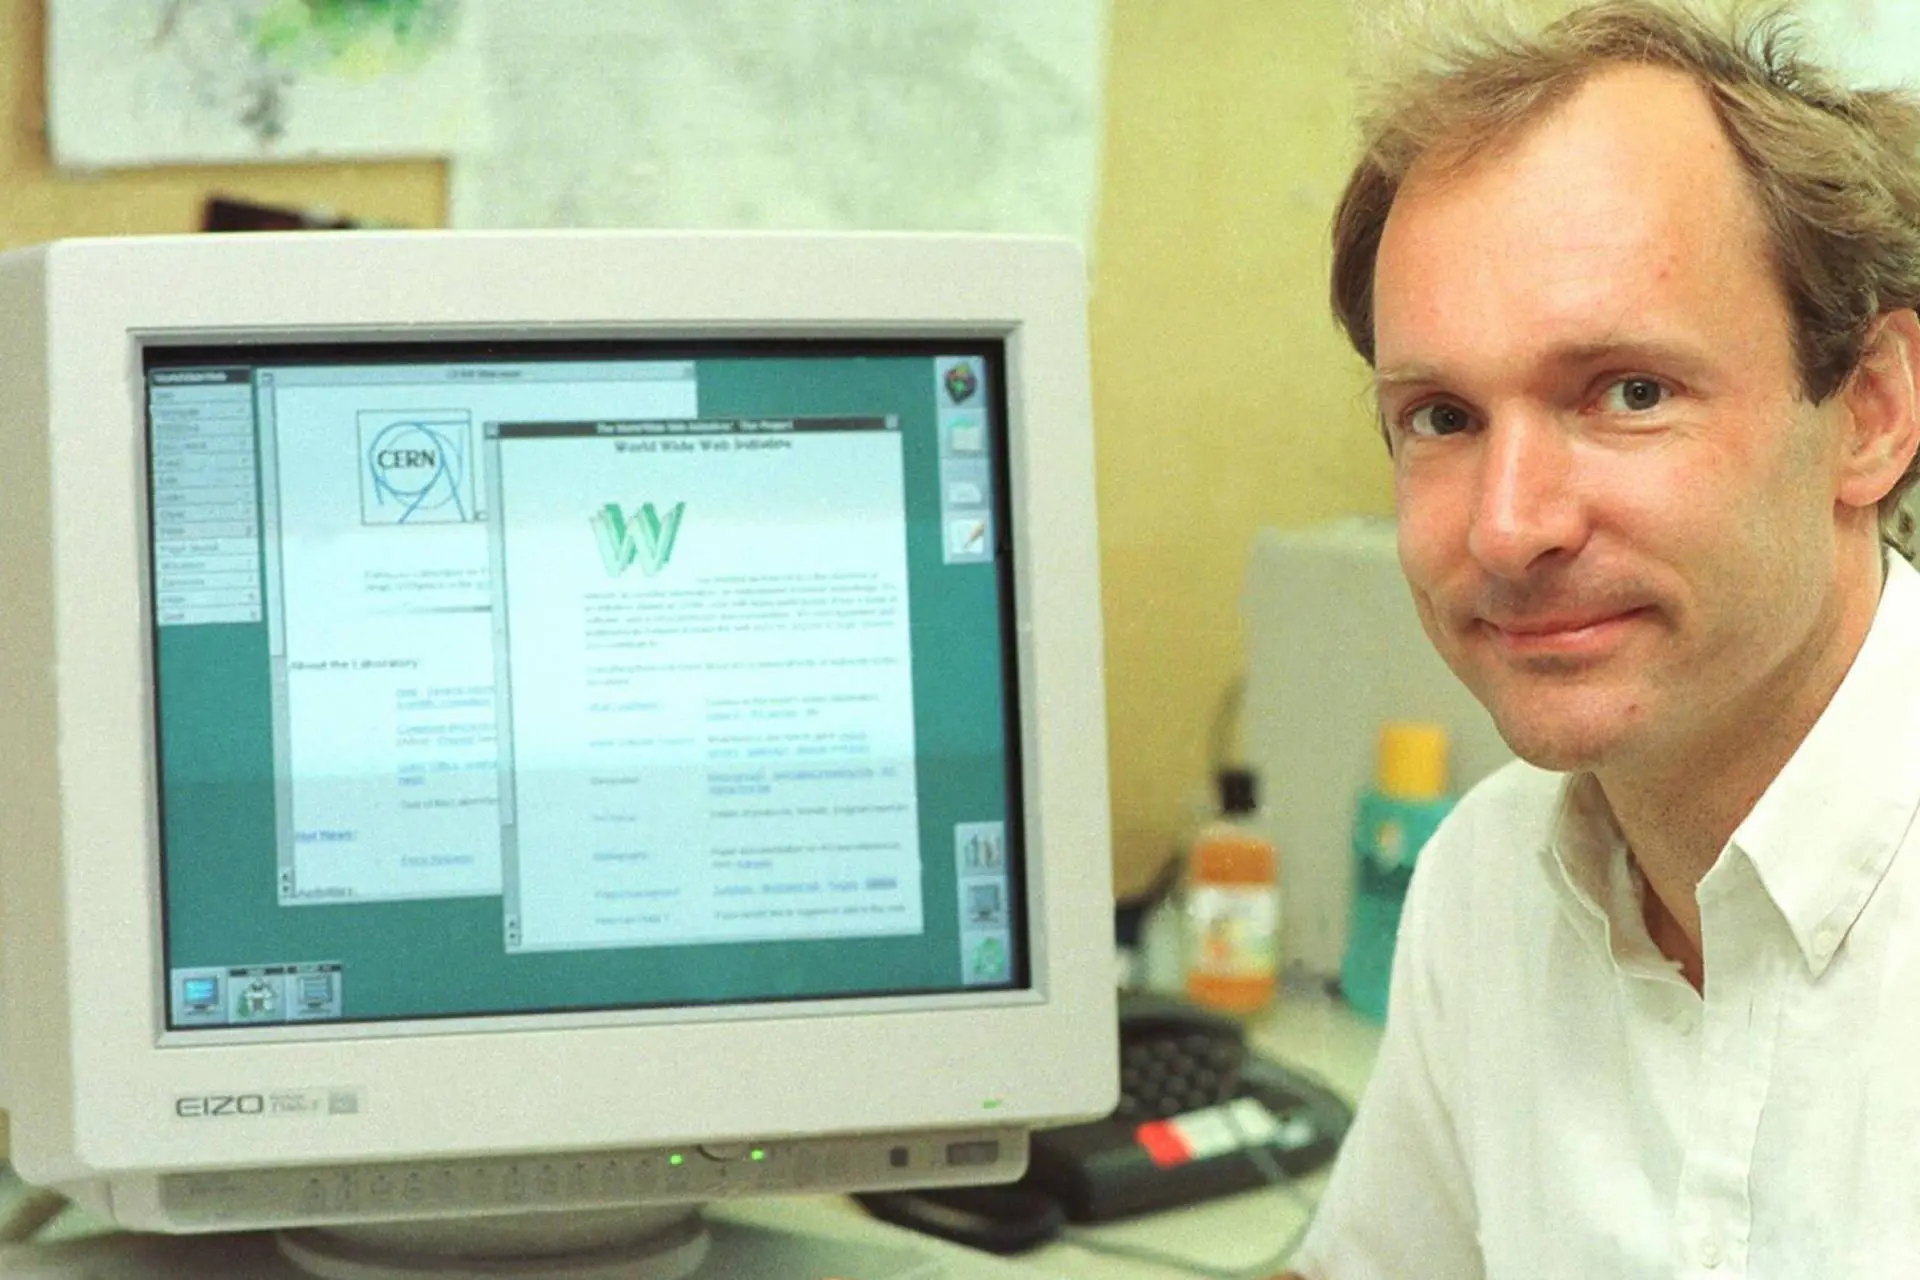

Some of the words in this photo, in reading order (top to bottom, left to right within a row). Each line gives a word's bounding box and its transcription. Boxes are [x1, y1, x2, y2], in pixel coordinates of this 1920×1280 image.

[614, 439, 657, 453] World
[661, 438, 695, 452] Wide
[699, 437, 731, 451] Web
[377, 449, 435, 469] CERN
[176, 1094, 264, 1117] EIZO
